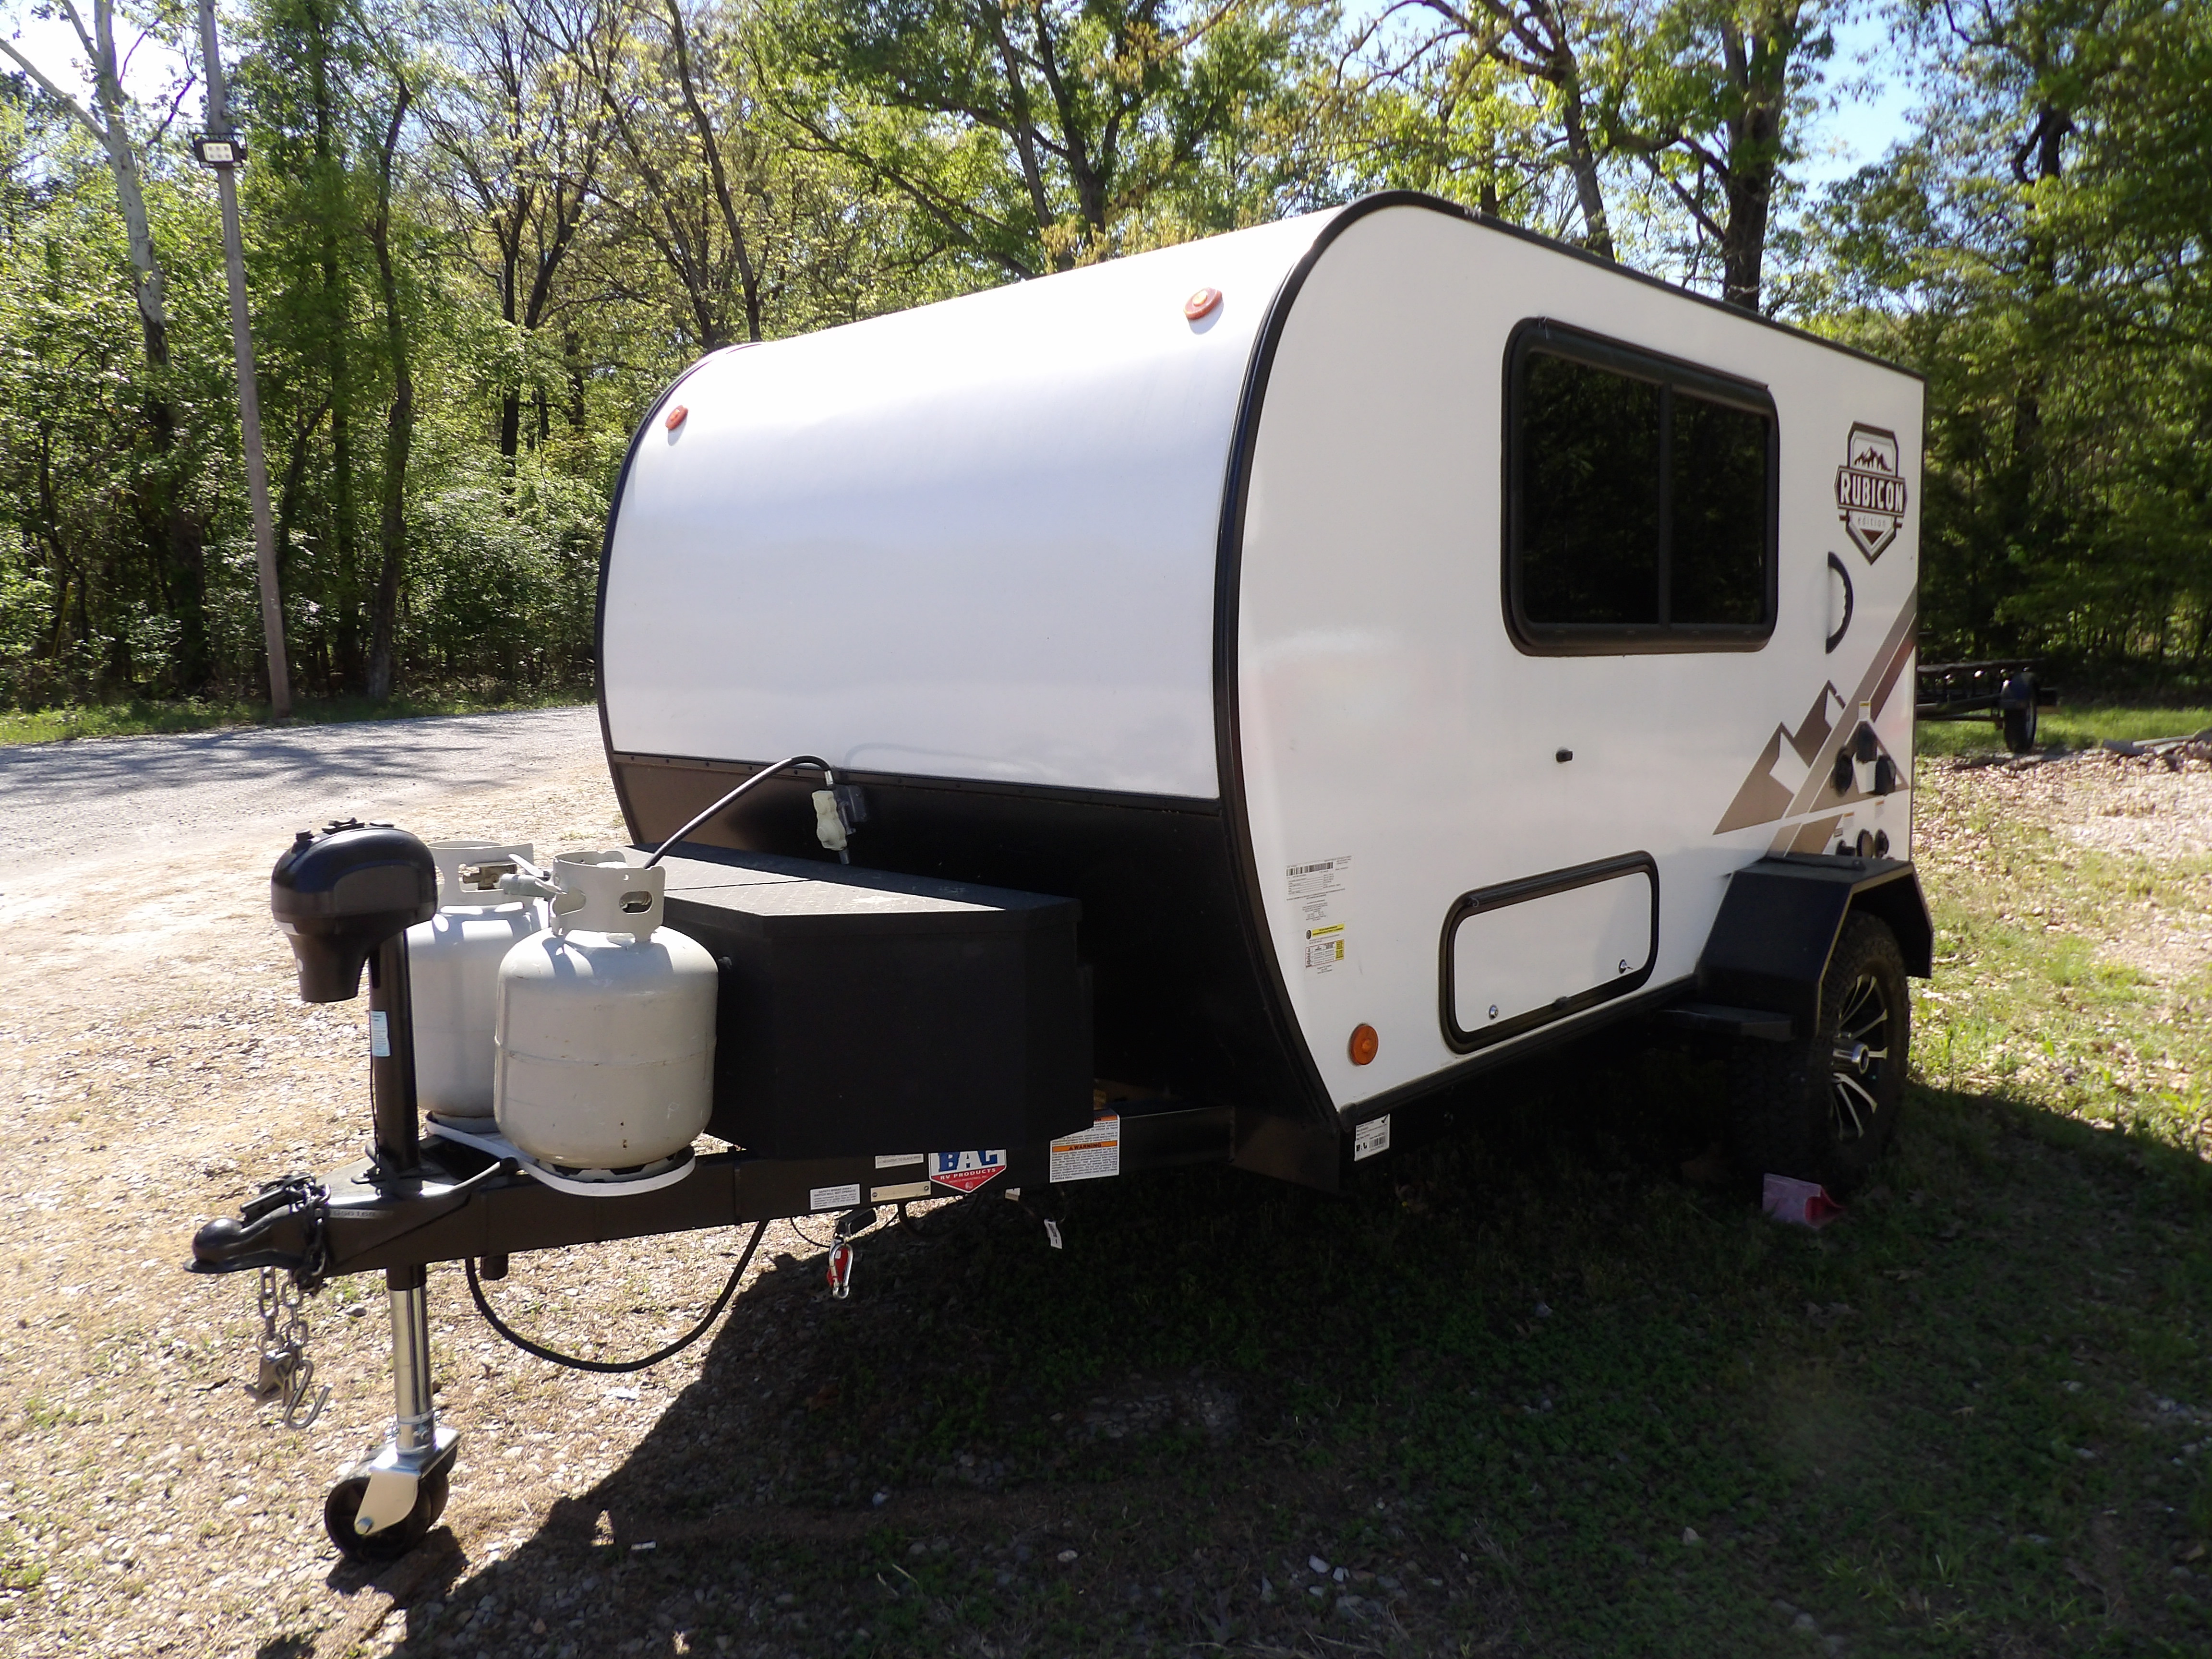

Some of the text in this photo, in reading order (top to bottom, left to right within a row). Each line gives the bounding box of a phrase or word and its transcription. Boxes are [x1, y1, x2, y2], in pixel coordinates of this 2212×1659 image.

[1839, 471, 1904, 512] RUBICON
[1857, 517, 1886, 528] edition
[953, 1168, 997, 1178] PRODUCTS
